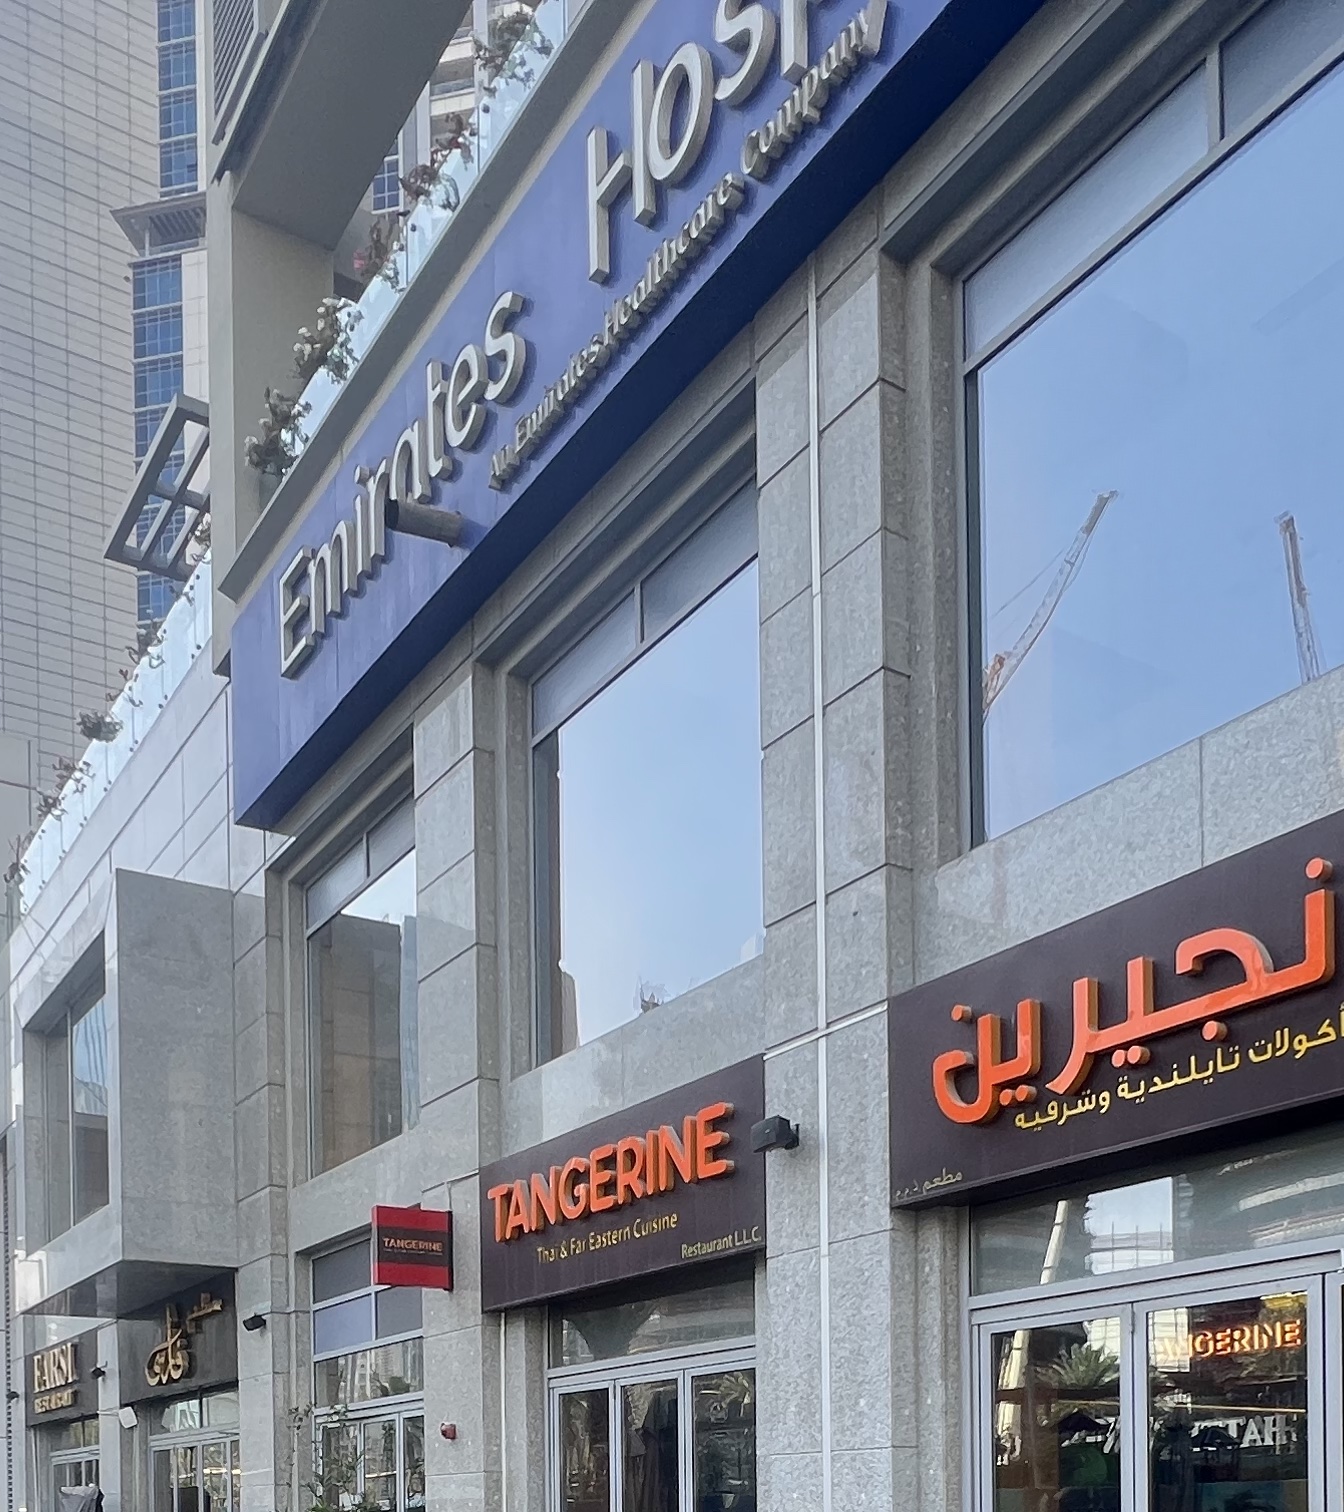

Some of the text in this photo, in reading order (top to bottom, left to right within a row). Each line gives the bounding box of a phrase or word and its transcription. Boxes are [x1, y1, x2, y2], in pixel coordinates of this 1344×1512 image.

[514, 332, 610, 458] Emirates
[603, 172, 745, 350] Healthcare
[280, 290, 526, 679] Emirates
[1117, 1045, 1241, 1104] تايلندية
[487, 1101, 735, 1243] TANGERINE
[923, 1167, 963, 1196] مطعم
[382, 1237, 443, 1252] TANGERINE
[559, 1241, 568, 1259] &
[570, 1238, 587, 1256] Far
[588, 1225, 631, 1251] Eastern
[633, 1212, 678, 1238] Cuisine
[681, 1234, 733, 1259] Restaurant
[33, 1342, 77, 1394] FARSI
